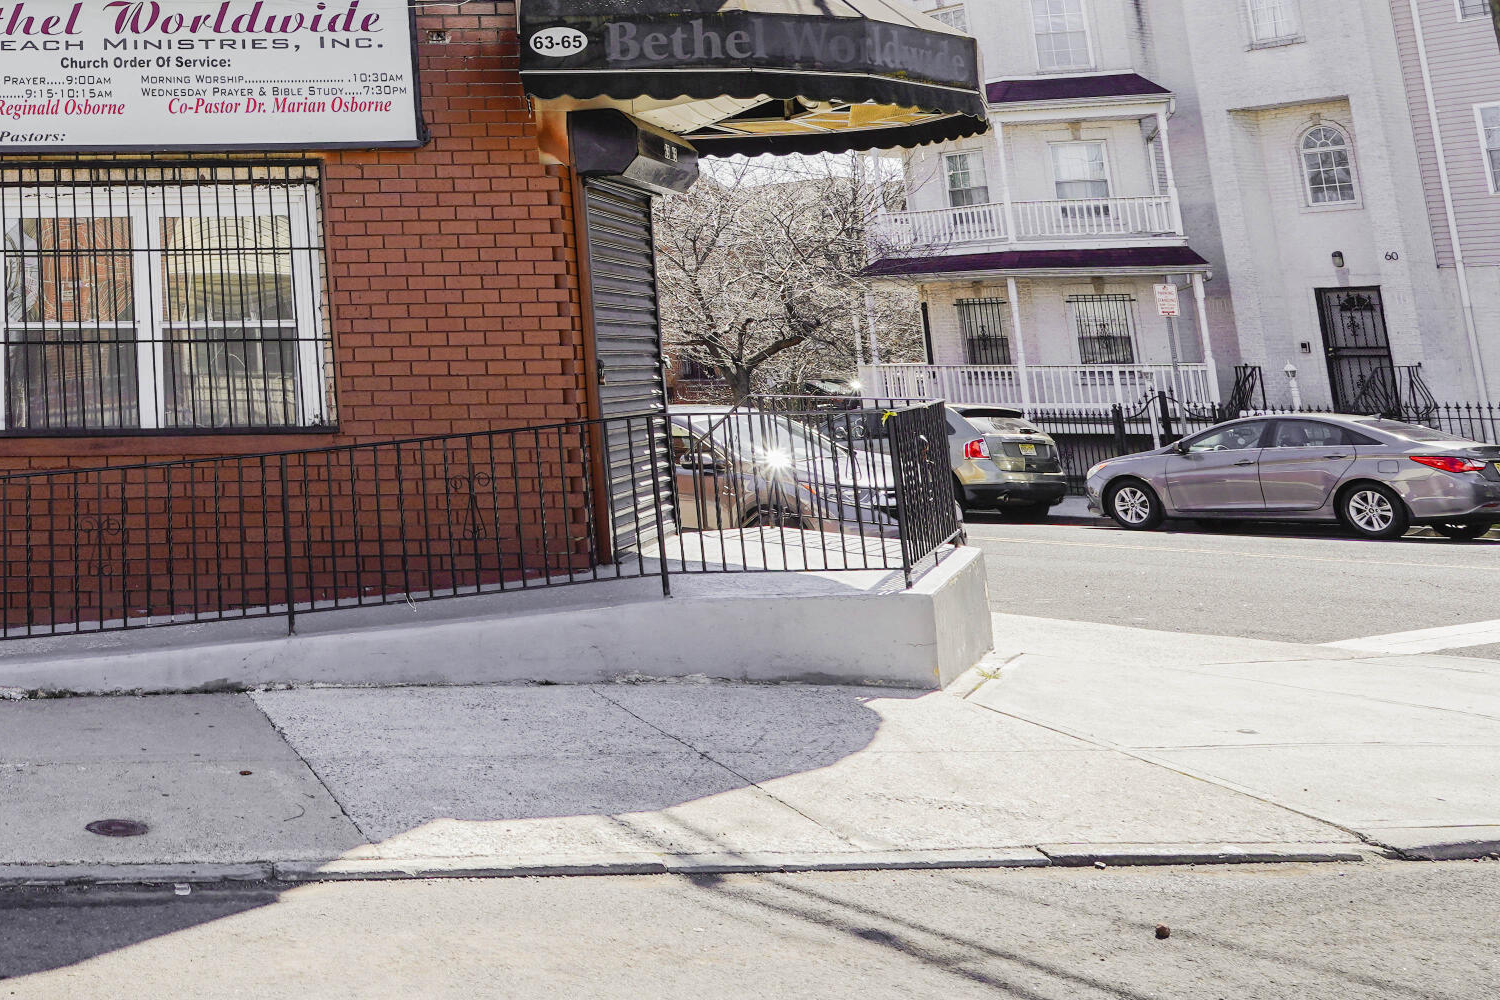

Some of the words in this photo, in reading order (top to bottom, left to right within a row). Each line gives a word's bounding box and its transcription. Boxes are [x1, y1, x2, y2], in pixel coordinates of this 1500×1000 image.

[102, 0, 384, 35] Worldwide
[532, 34, 583, 50] 63-65
[605, 17, 769, 62] Bethel
[780, 20, 971, 82] Worldwide
[60, 56, 109, 69] Church
[113, 56, 152, 69] Order
[156, 56, 171, 68] Of
[175, 56, 232, 68] Service:
[141, 75, 191, 84] MORNING
[140, 87, 208, 97] WEDNESDAY
[212, 87, 254, 97] PRAYER
[258, 87, 267, 96] &
[271, 86, 303, 96] BIBLE
[64, 98, 126, 116] Osborne
[168, 97, 241, 115] Co-Pastor
[245, 98, 267, 114] Dr.
[271, 97, 327, 114] Marian
[331, 96, 393, 113] Osborne
[1384, 251, 1399, 261] 60
